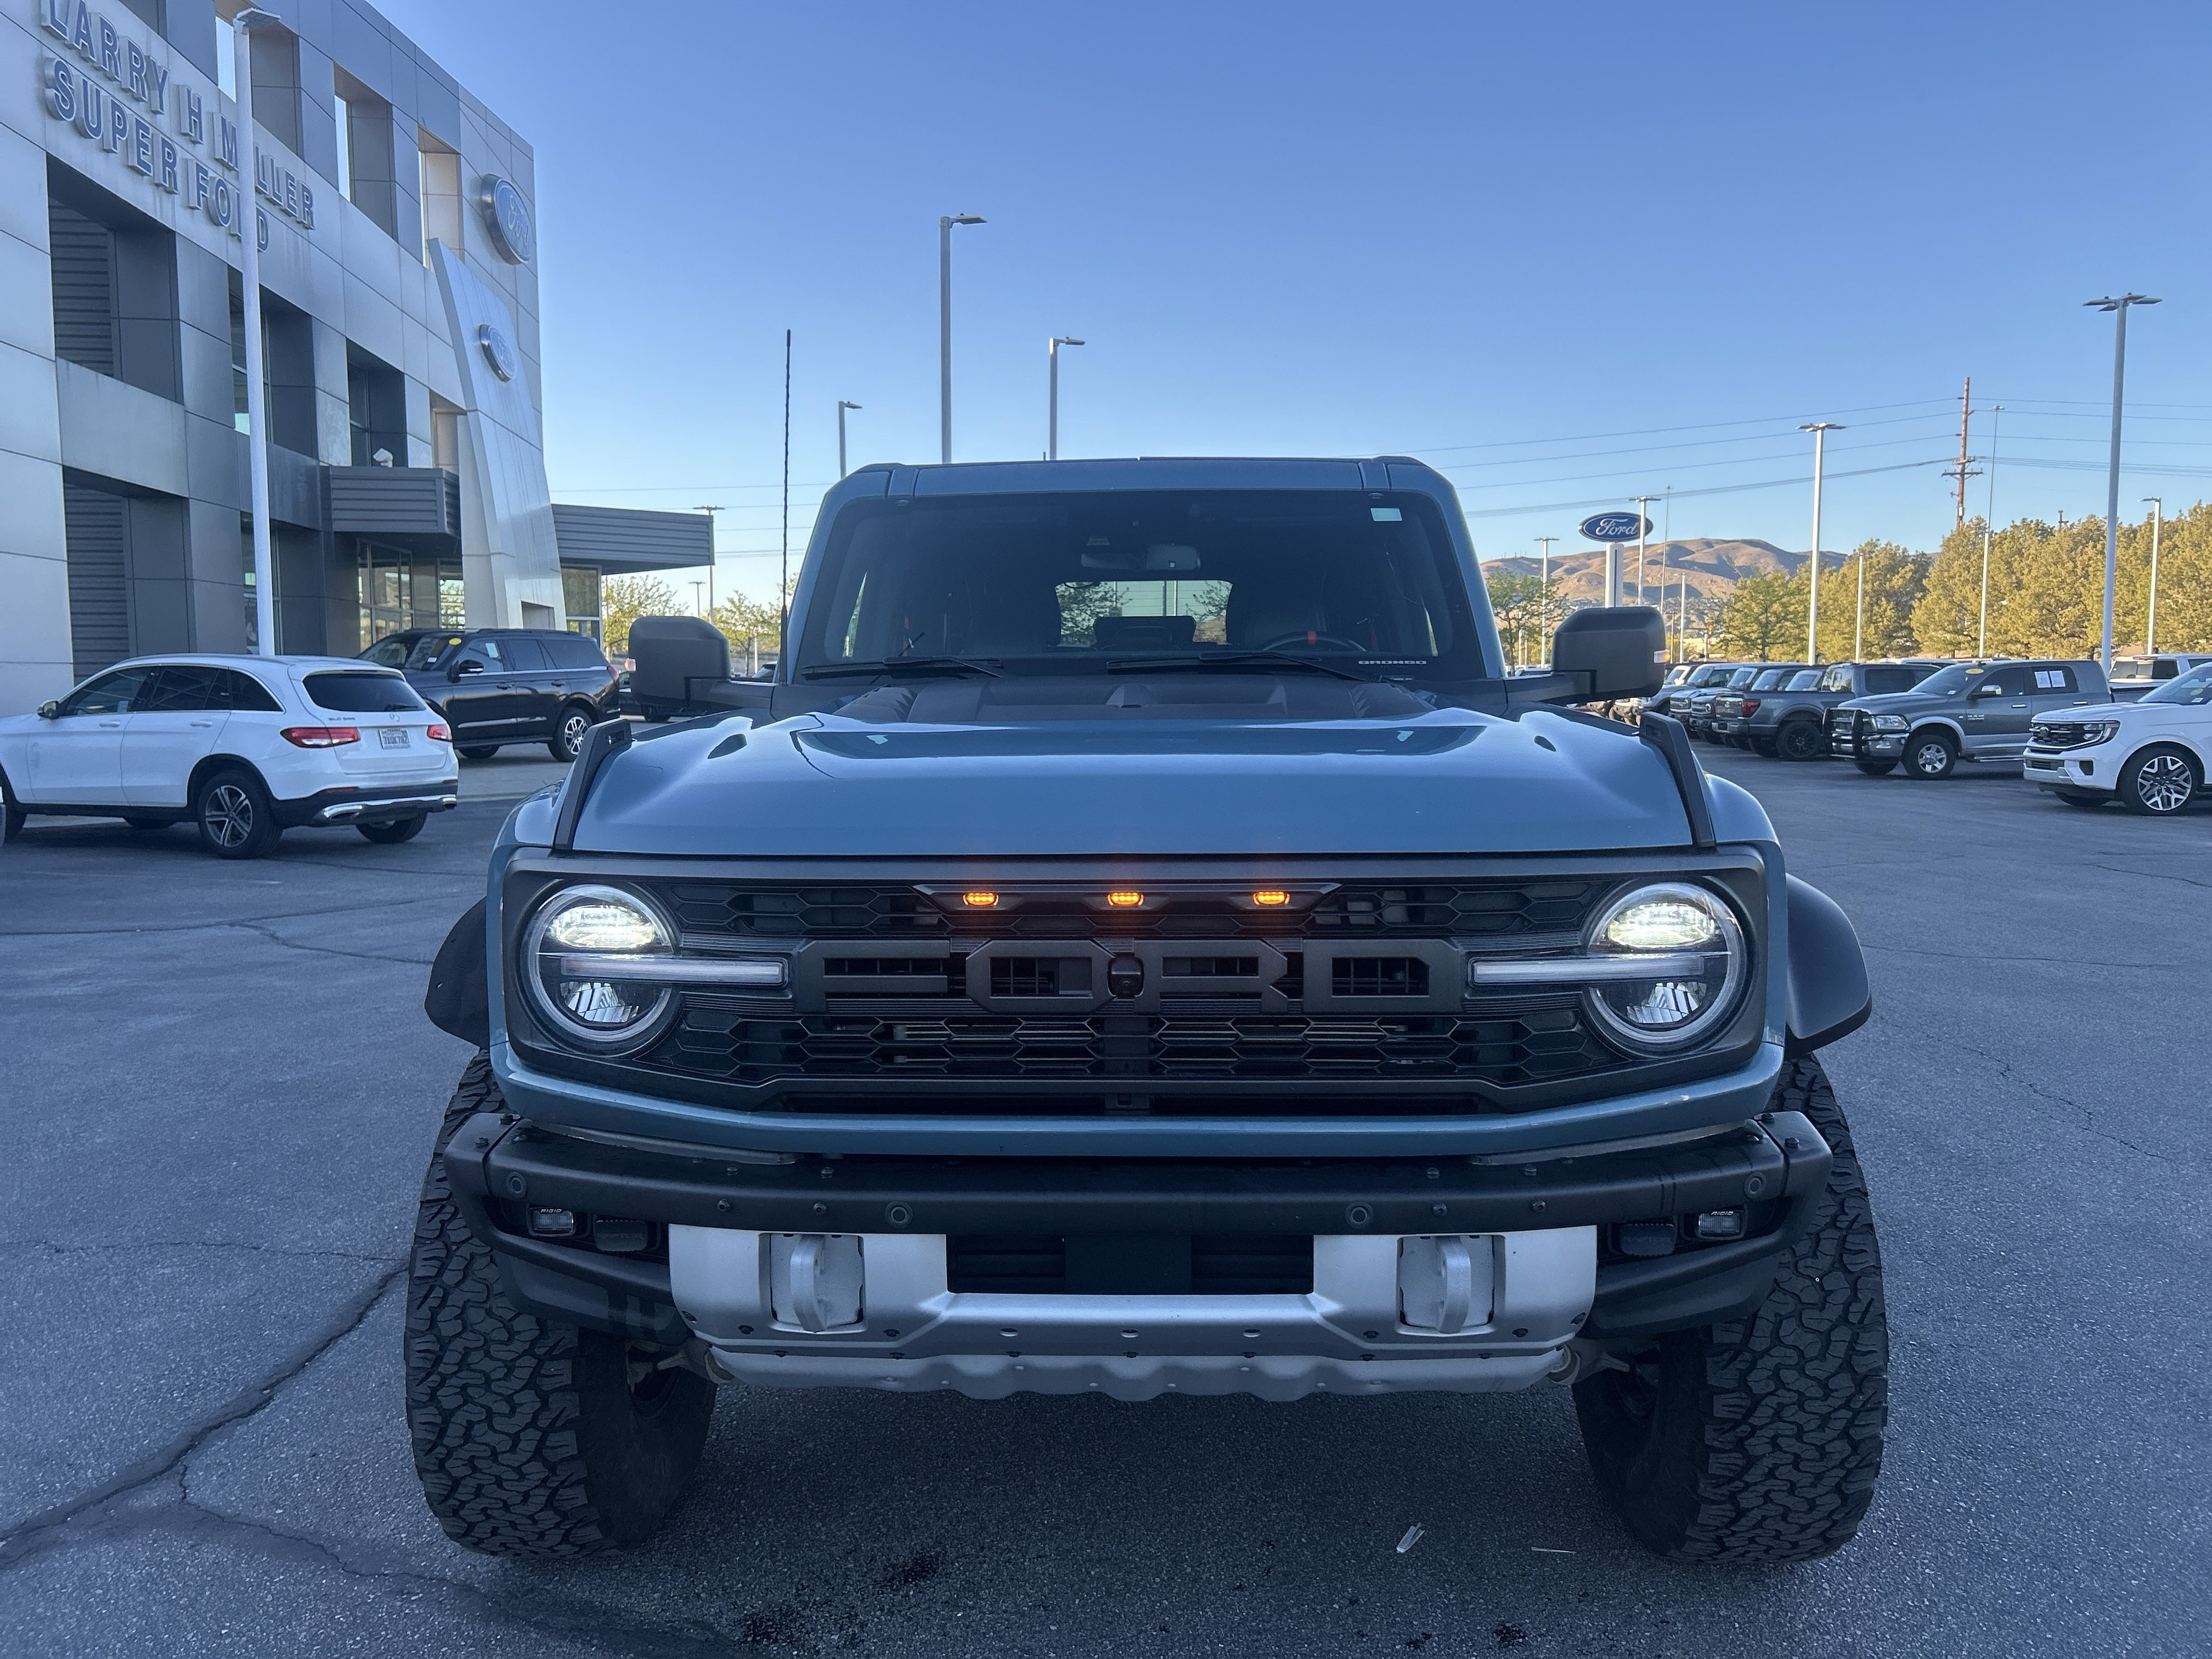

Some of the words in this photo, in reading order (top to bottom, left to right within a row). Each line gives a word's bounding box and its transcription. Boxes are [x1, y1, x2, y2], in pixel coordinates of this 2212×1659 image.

[47, 0, 169, 114] LARRY
[184, 86, 204, 145] H
[218, 112, 315, 230] MLLER
[50, 59, 180, 195] SUPER
[1595, 518, 1638, 536] Ford
[794, 938, 1461, 1014] FORD
